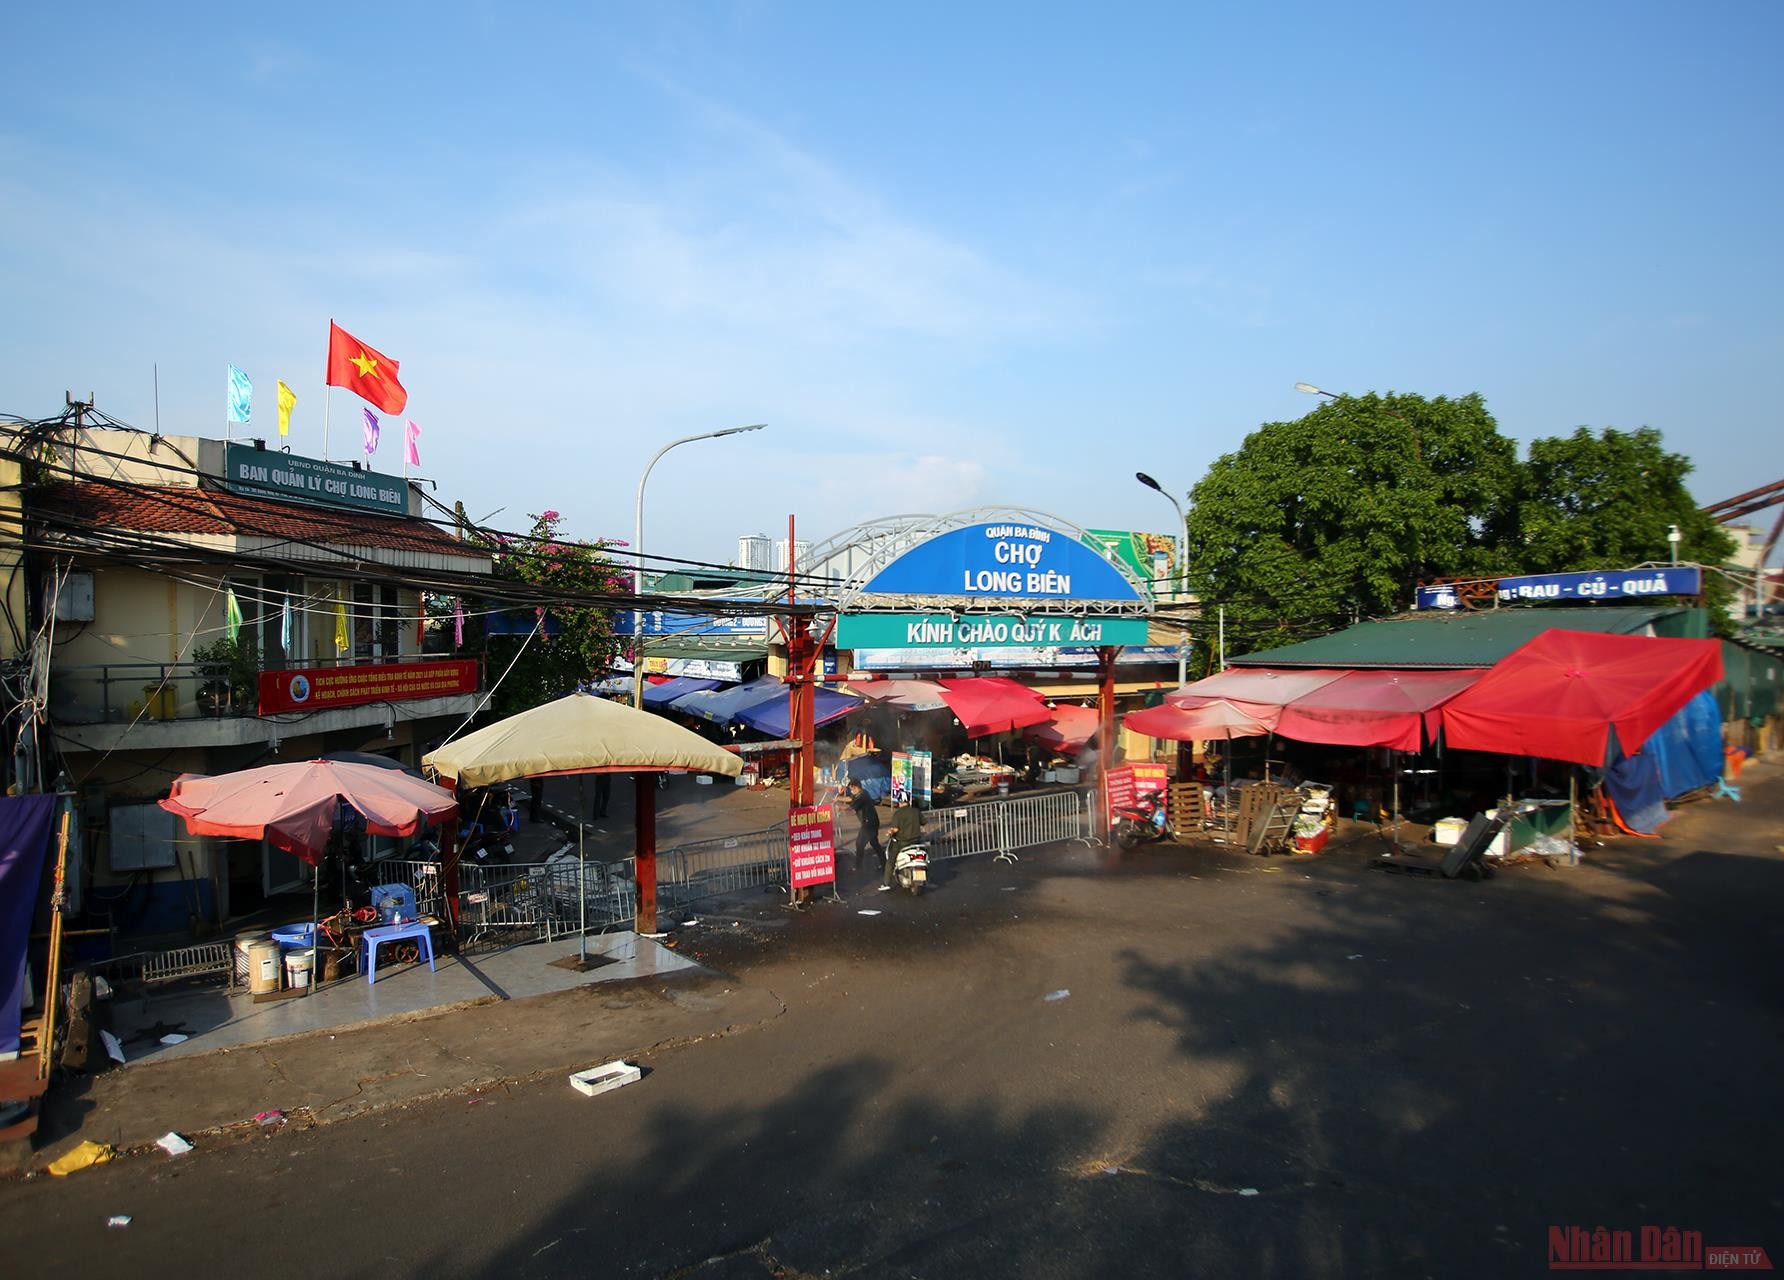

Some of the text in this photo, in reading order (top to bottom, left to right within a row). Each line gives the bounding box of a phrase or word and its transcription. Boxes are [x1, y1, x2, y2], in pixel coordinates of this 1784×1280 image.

[288, 460, 311, 468] UBND
[313, 464, 335, 474] QUẬN
[240, 464, 268, 482] BAN
[272, 468, 304, 488] QUẢN
[308, 474, 322, 490] LÝ
[325, 480, 347, 498] CHỢ
[350, 484, 376, 500] LONG
[379, 488, 400, 504] BIÊN
[986, 525, 1050, 543] QUẬN BA ĐÌNH
[995, 541, 1042, 568] CHỢ
[964, 570, 1070, 594] LONG BIÊN
[1518, 584, 1560, 598] RAU
[1578, 577, 1606, 595] CỦ
[1622, 573, 1668, 594] QUẢ
[907, 619, 952, 643] KÍNH
[958, 620, 1008, 643] CHÀO
[1012, 619, 1046, 643] QUÝ
